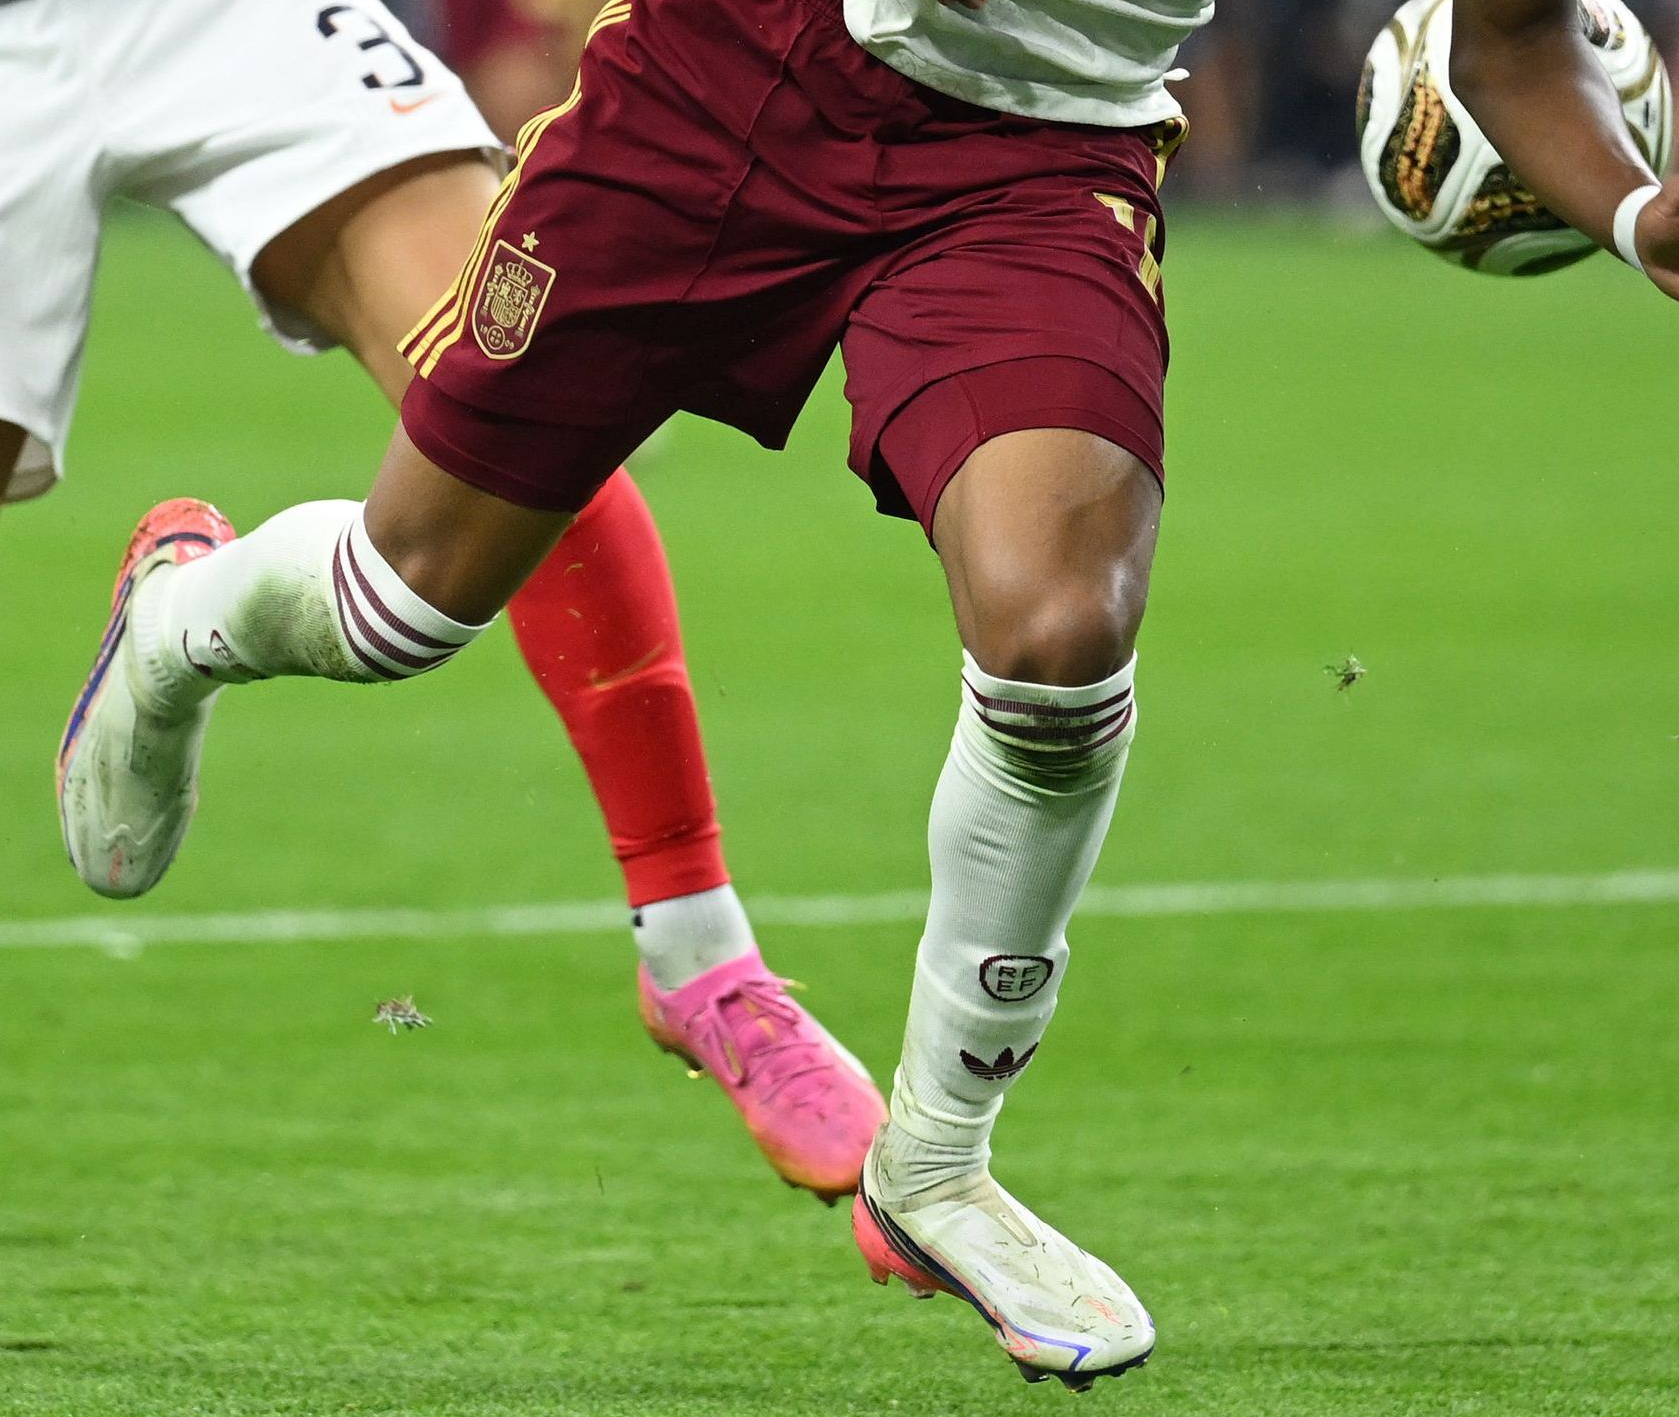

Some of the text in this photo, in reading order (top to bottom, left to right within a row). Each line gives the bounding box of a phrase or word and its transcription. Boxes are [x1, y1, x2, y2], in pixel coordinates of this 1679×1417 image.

[317, 5, 425, 89] 3
[998, 965, 1040, 978] RF
[997, 978, 1037, 992] EF
